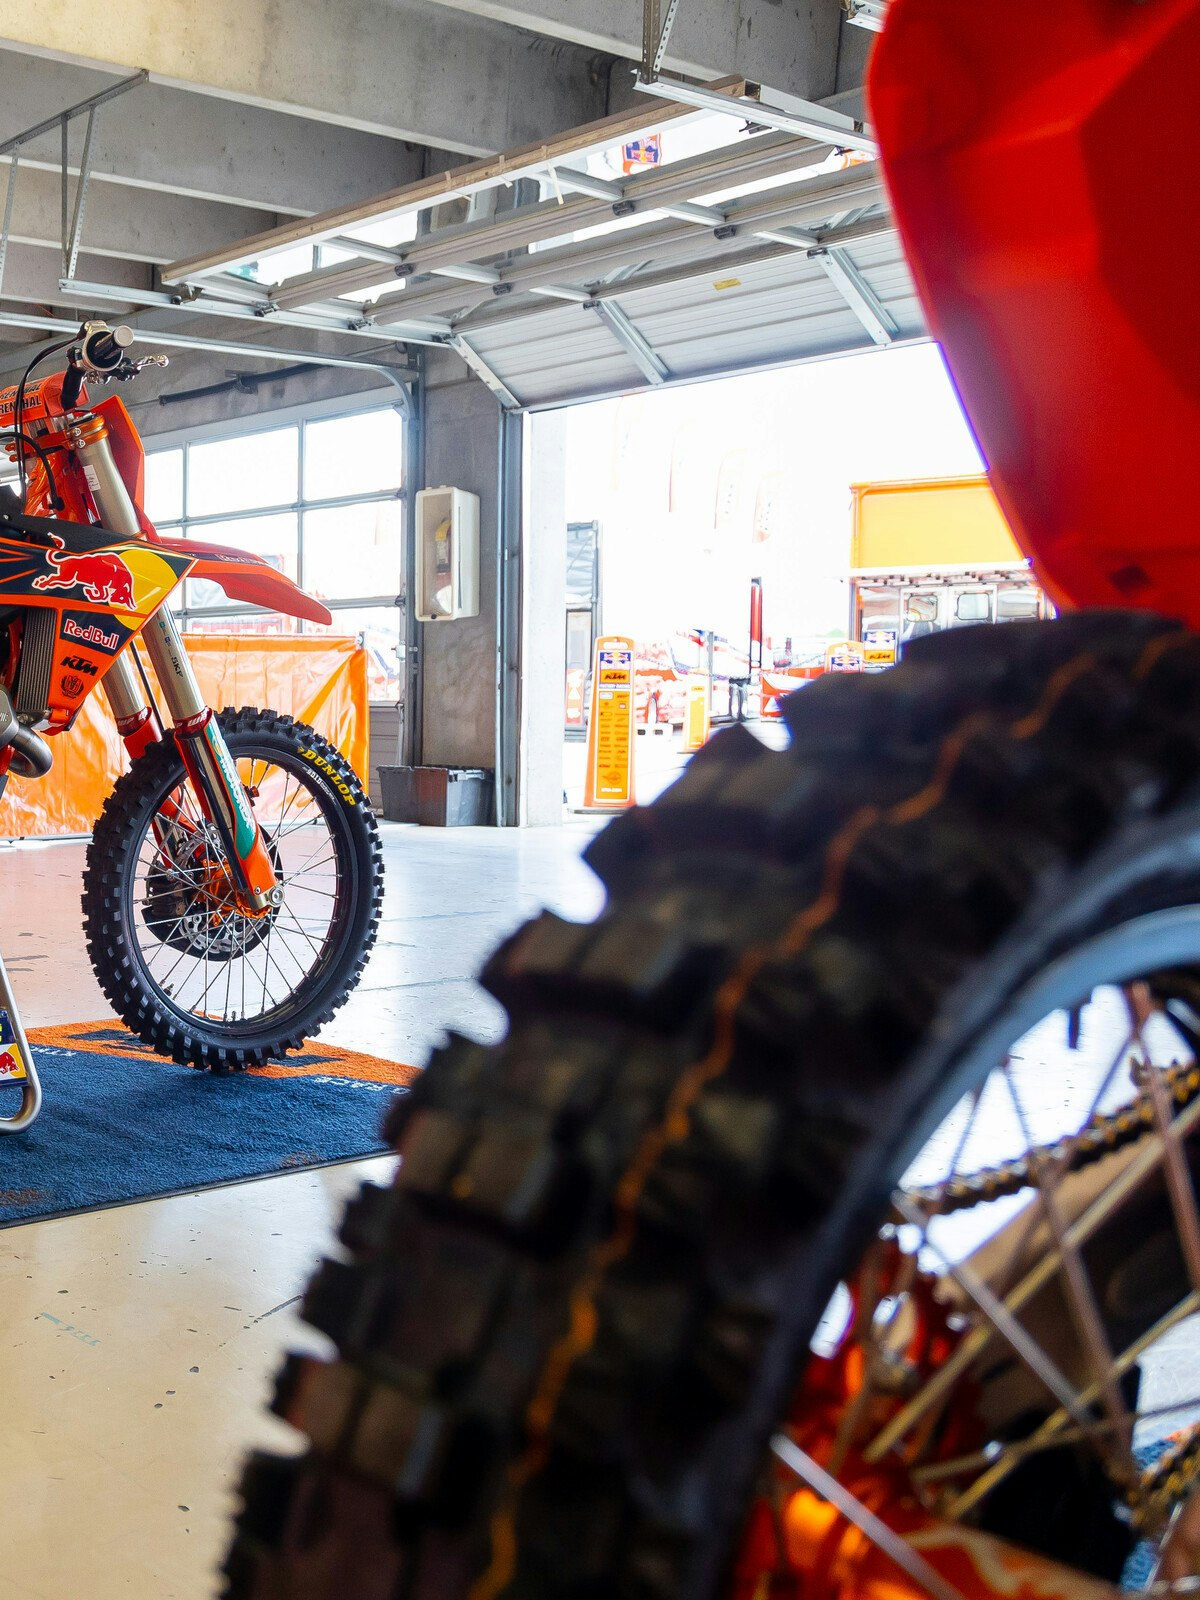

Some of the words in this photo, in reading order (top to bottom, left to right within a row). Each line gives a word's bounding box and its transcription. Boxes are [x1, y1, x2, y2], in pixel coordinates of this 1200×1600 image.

[64, 618, 93, 640] Red
[92, 628, 120, 650] Bull
[60, 655, 99, 676] KTM
[171, 656, 184, 678] SKF
[301, 749, 356, 806] DUNLOP
